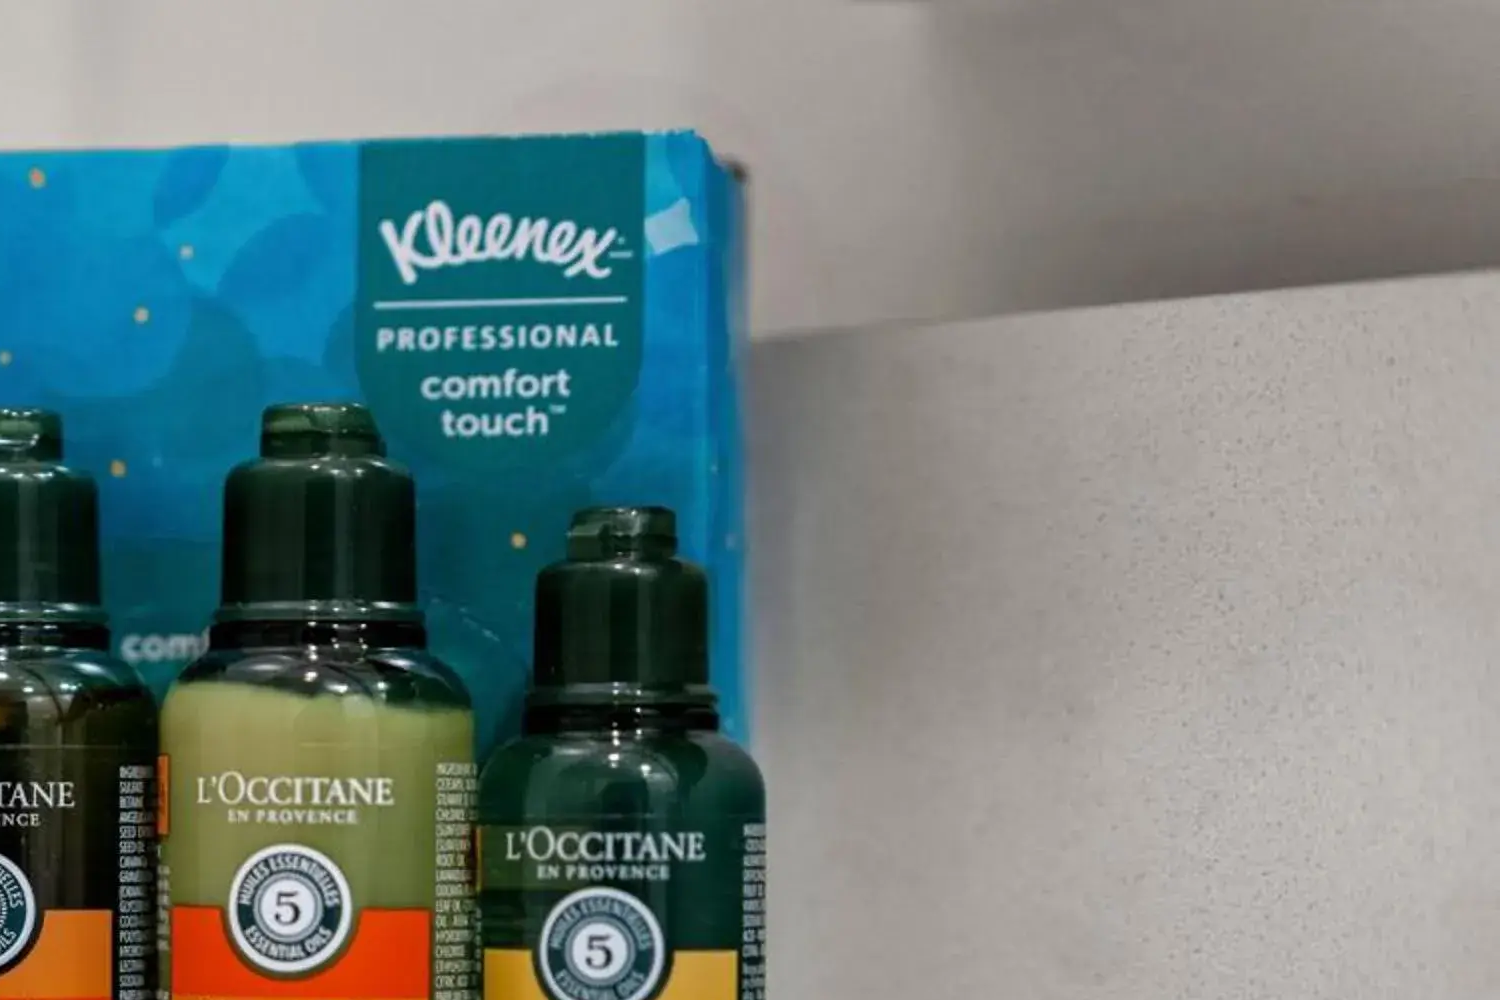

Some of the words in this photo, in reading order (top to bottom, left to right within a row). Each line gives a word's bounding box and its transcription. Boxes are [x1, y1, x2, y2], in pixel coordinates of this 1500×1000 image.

[380, 200, 618, 285] Kleenex
[376, 323, 619, 351] PROFESSIONAL
[420, 367, 571, 401] comfort
[197, 771, 394, 805] L'OCCITANE
[228, 809, 248, 822] EN
[257, 809, 357, 824] PROVENCE
[506, 826, 706, 861] L'OCCITANE
[537, 865, 559, 879] EN
[566, 865, 670, 880] PROVENCE
[274, 891, 300, 926] 5
[585, 934, 613, 970] 5
